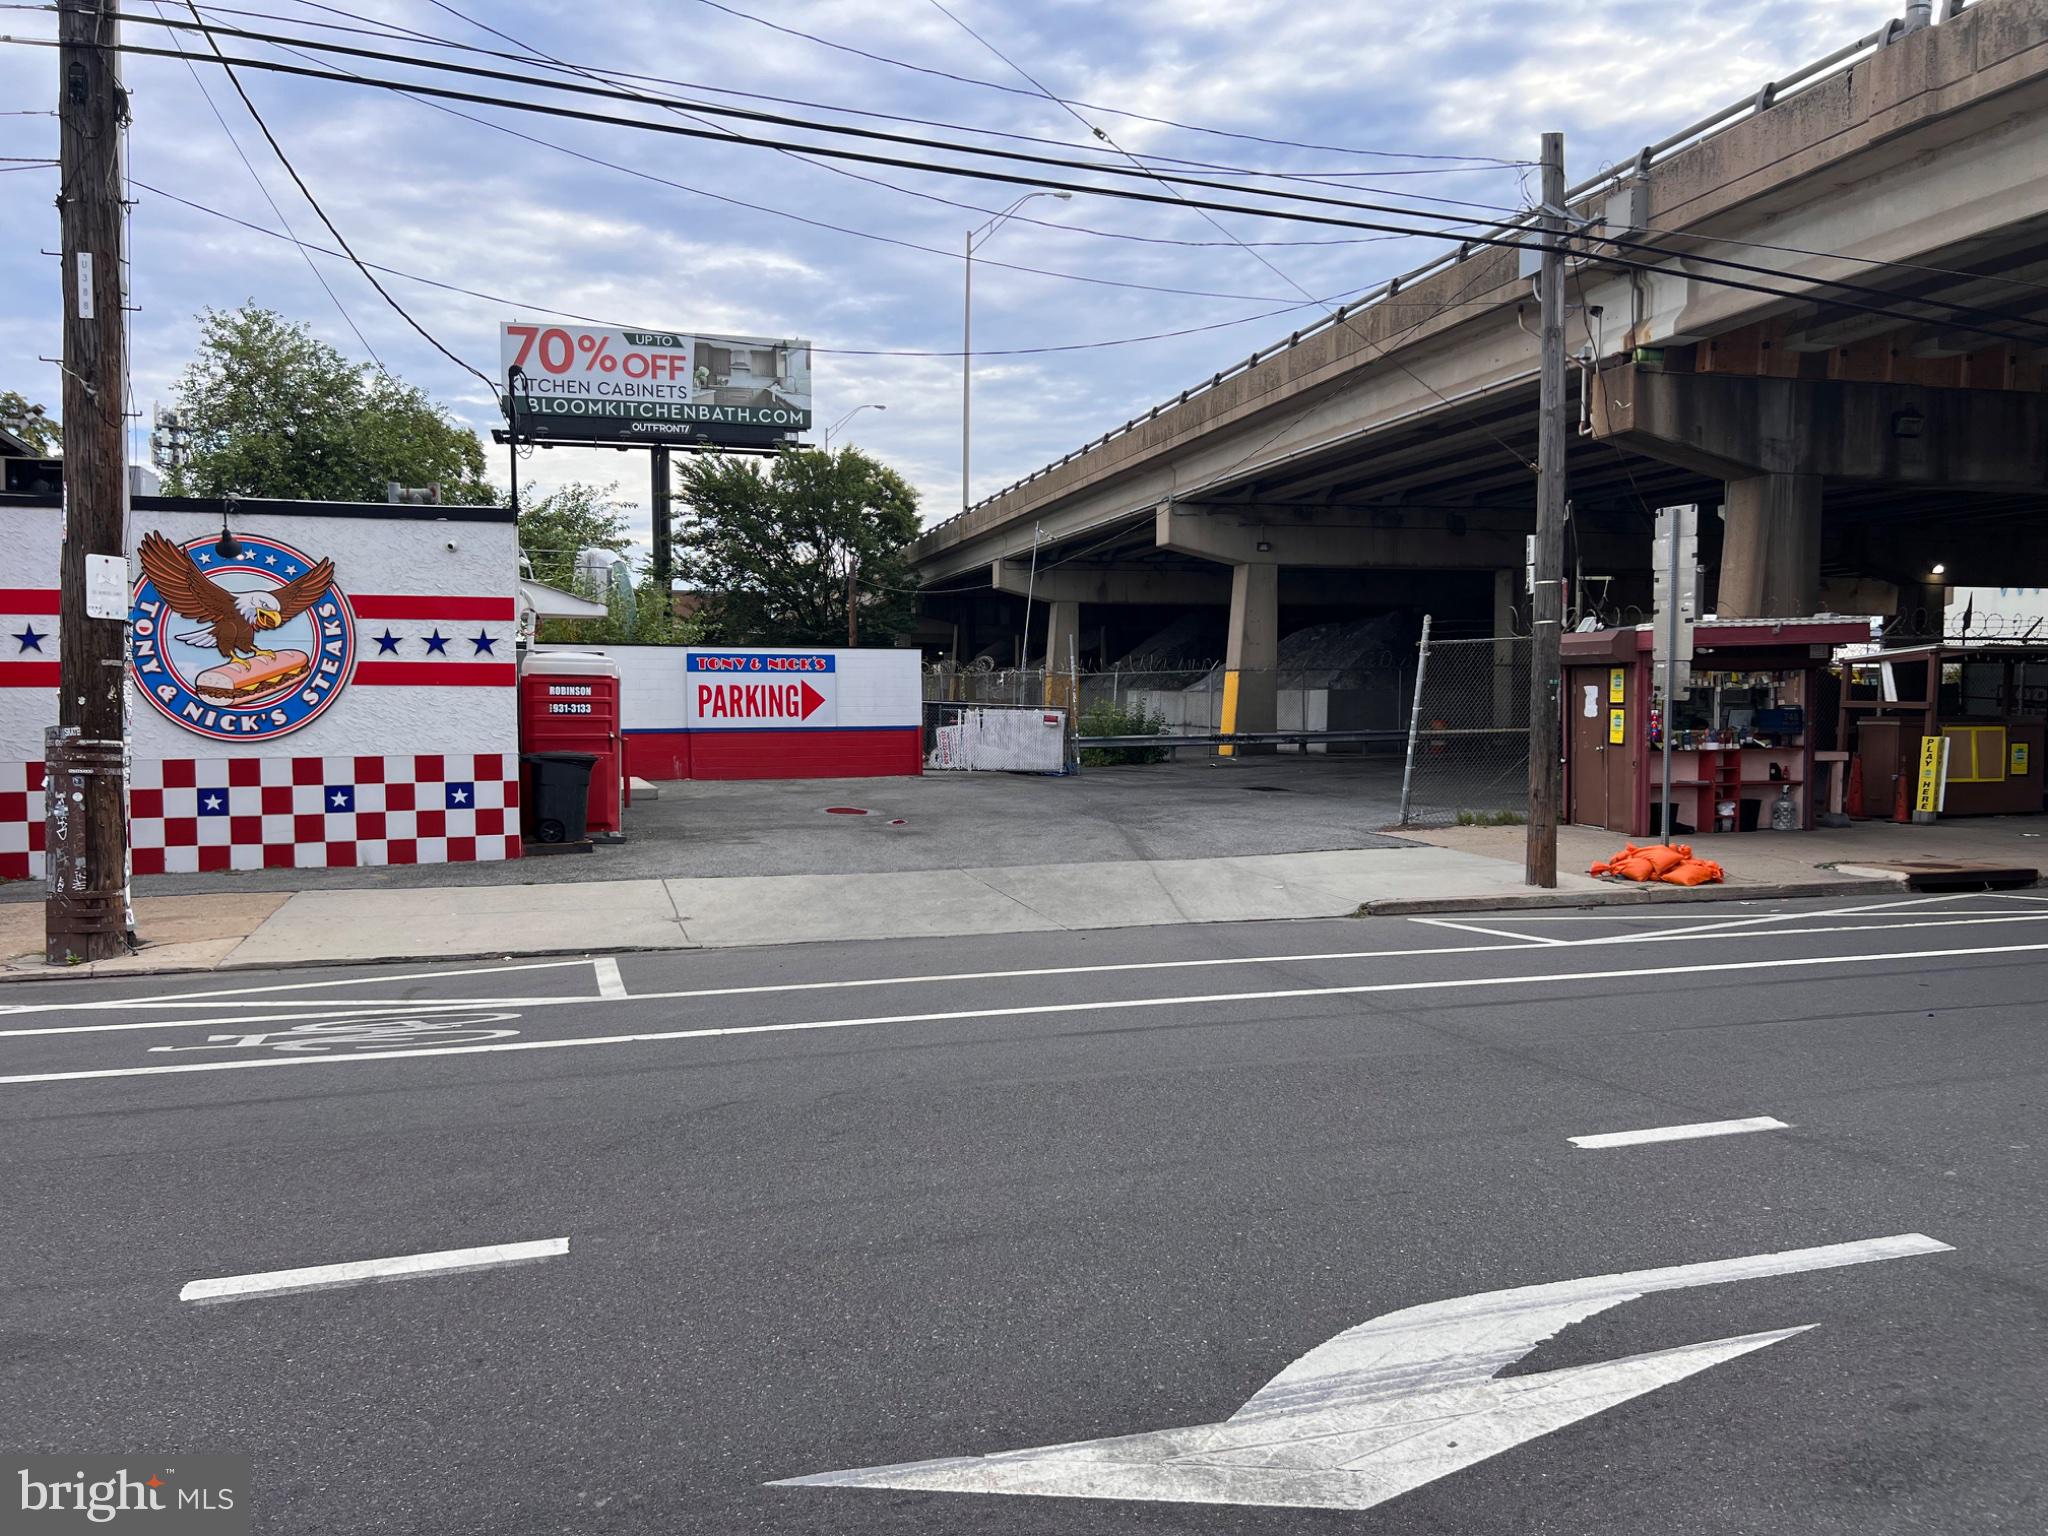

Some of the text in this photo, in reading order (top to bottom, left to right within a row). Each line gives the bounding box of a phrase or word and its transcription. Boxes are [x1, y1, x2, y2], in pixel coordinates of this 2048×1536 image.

[635, 334, 673, 347] UP TO
[507, 326, 686, 381] 70% OFF
[597, 381, 688, 399] CABINETS
[528, 398, 804, 425] BLOOMKITCHENBATH.COM
[135, 600, 162, 674] TONY
[156, 685, 178, 703] &
[182, 702, 288, 732] NICK'S
[302, 602, 344, 706] STEAKS
[696, 655, 827, 671] TONY & NICK'S
[548, 685, 592, 696] ROBINSON
[698, 684, 799, 718] PARKING
[552, 703, 592, 713] 931-3133
[1921, 739, 1934, 809] PLAY HERE
